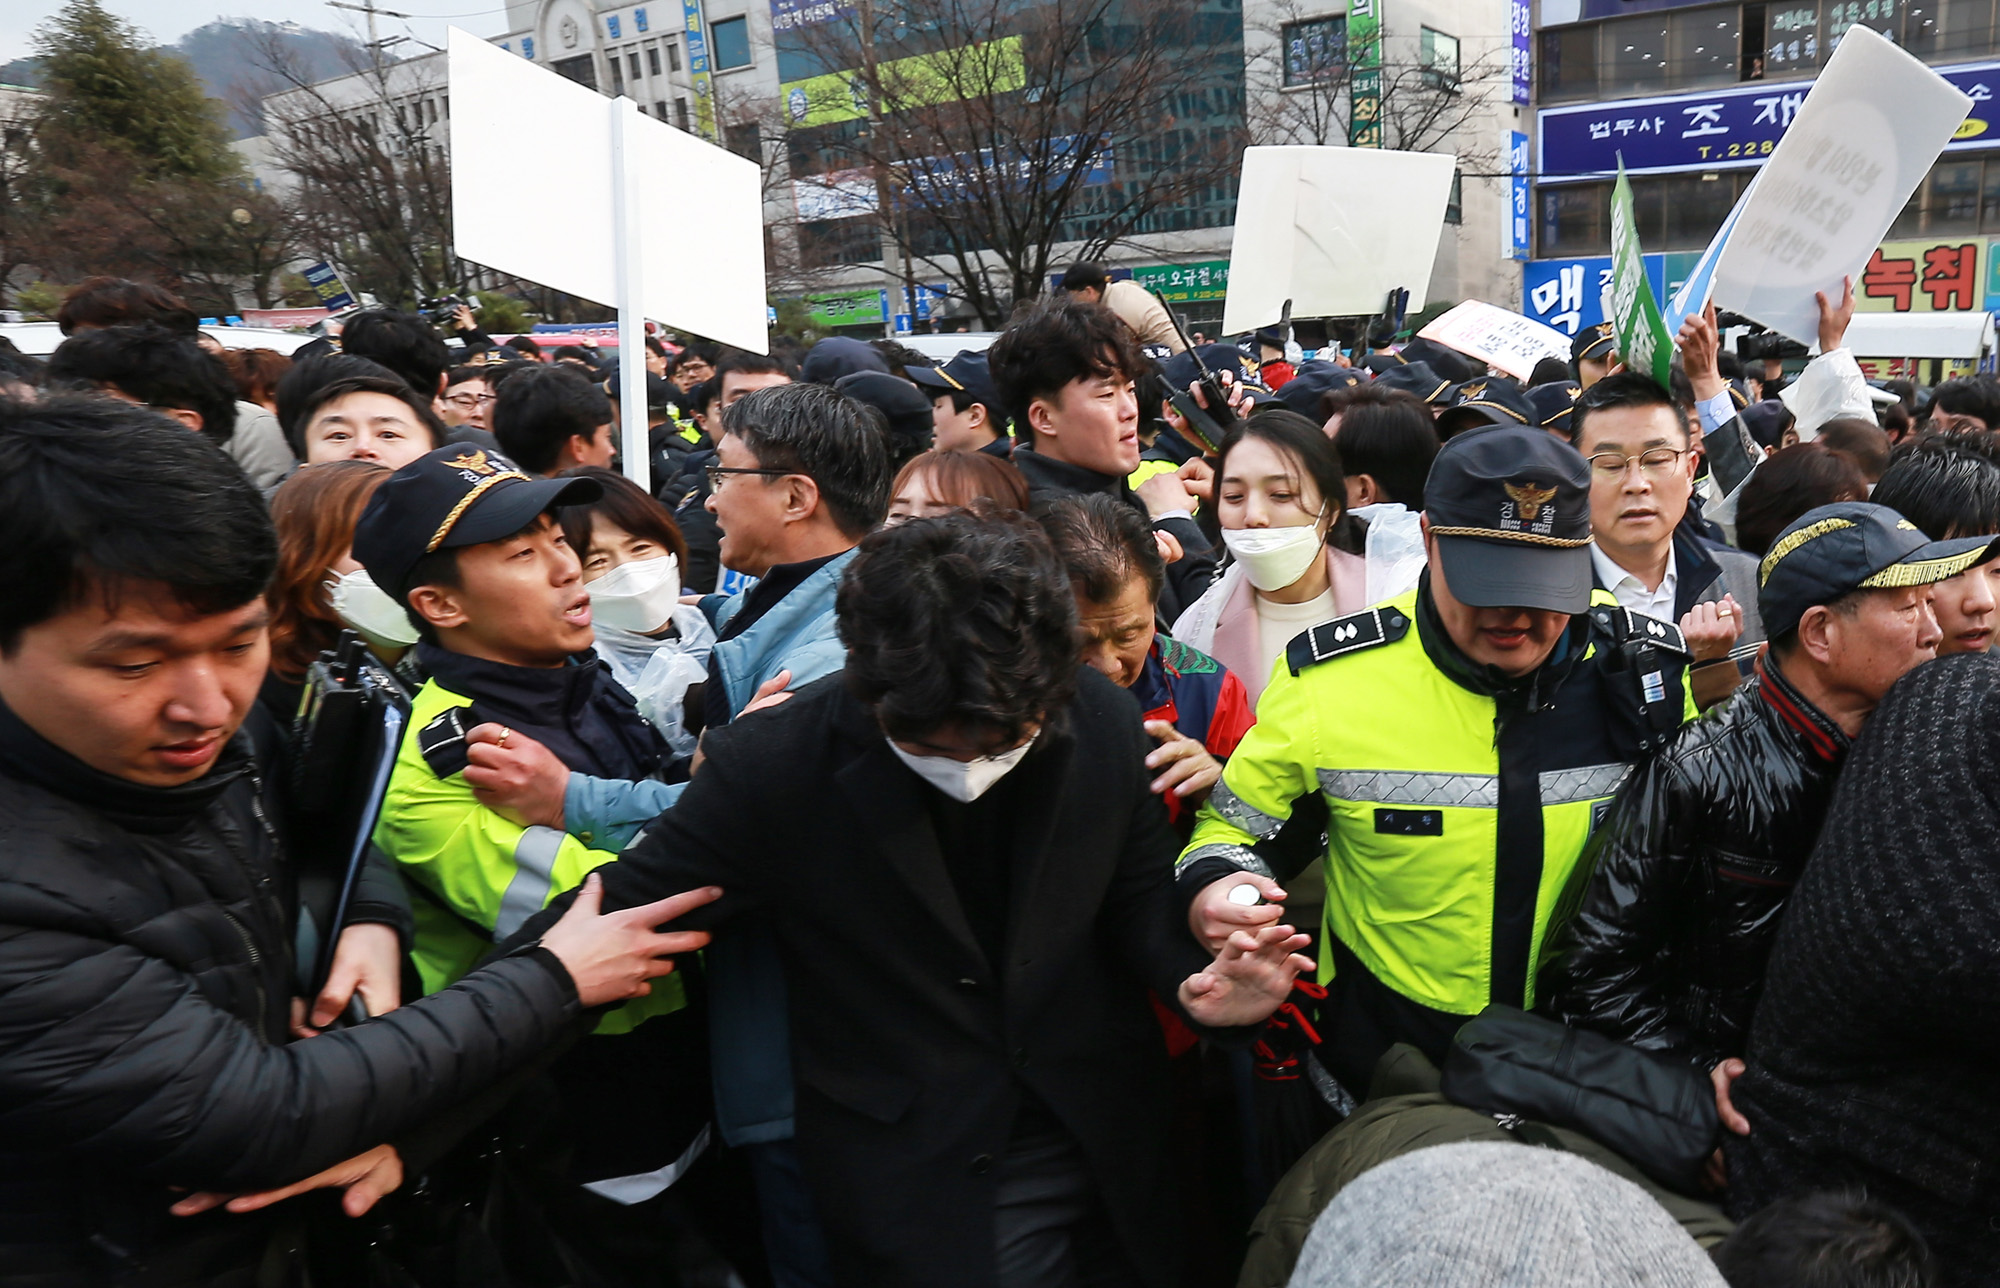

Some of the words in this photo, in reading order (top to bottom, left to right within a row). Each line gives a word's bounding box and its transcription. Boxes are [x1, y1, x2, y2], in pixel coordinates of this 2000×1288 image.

[1589, 116, 1665, 140] 법무사
[1530, 263, 1586, 336] 맥
[1863, 243, 1978, 312] 녹취
